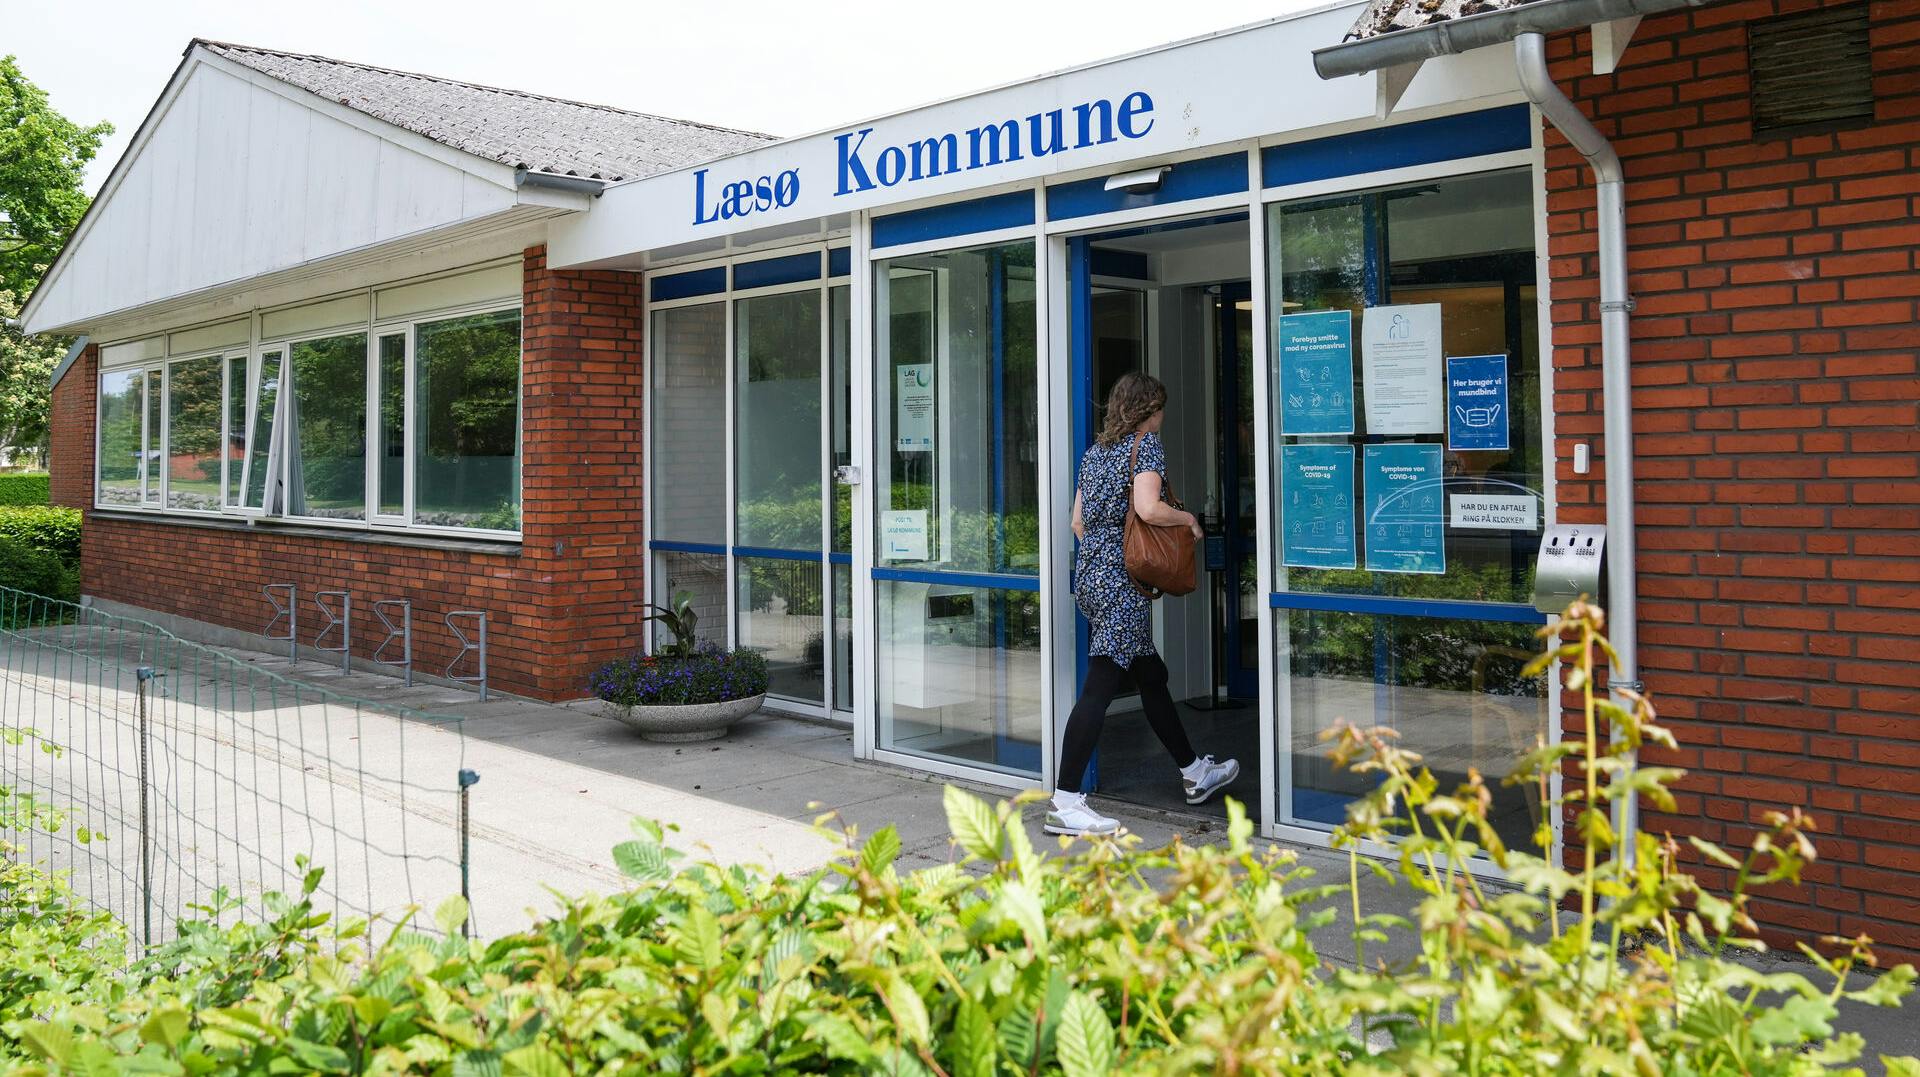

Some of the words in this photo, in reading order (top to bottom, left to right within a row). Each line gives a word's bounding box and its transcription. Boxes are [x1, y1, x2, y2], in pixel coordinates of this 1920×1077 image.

[692, 167, 800, 226] Læsø
[833, 91, 1155, 197] Kommune
[1309, 342, 1345, 350] coronavirus
[1468, 379, 1493, 387] bruger
[1458, 388, 1496, 396] mundbind
[1381, 465, 1412, 473] Symptome
[1477, 503, 1488, 511] DU
[1500, 504, 1527, 512] AFTALE
[1462, 515, 1480, 523] RING
[1481, 514, 1491, 523] PÅ
[1492, 516, 1525, 524] KLOKKEN
